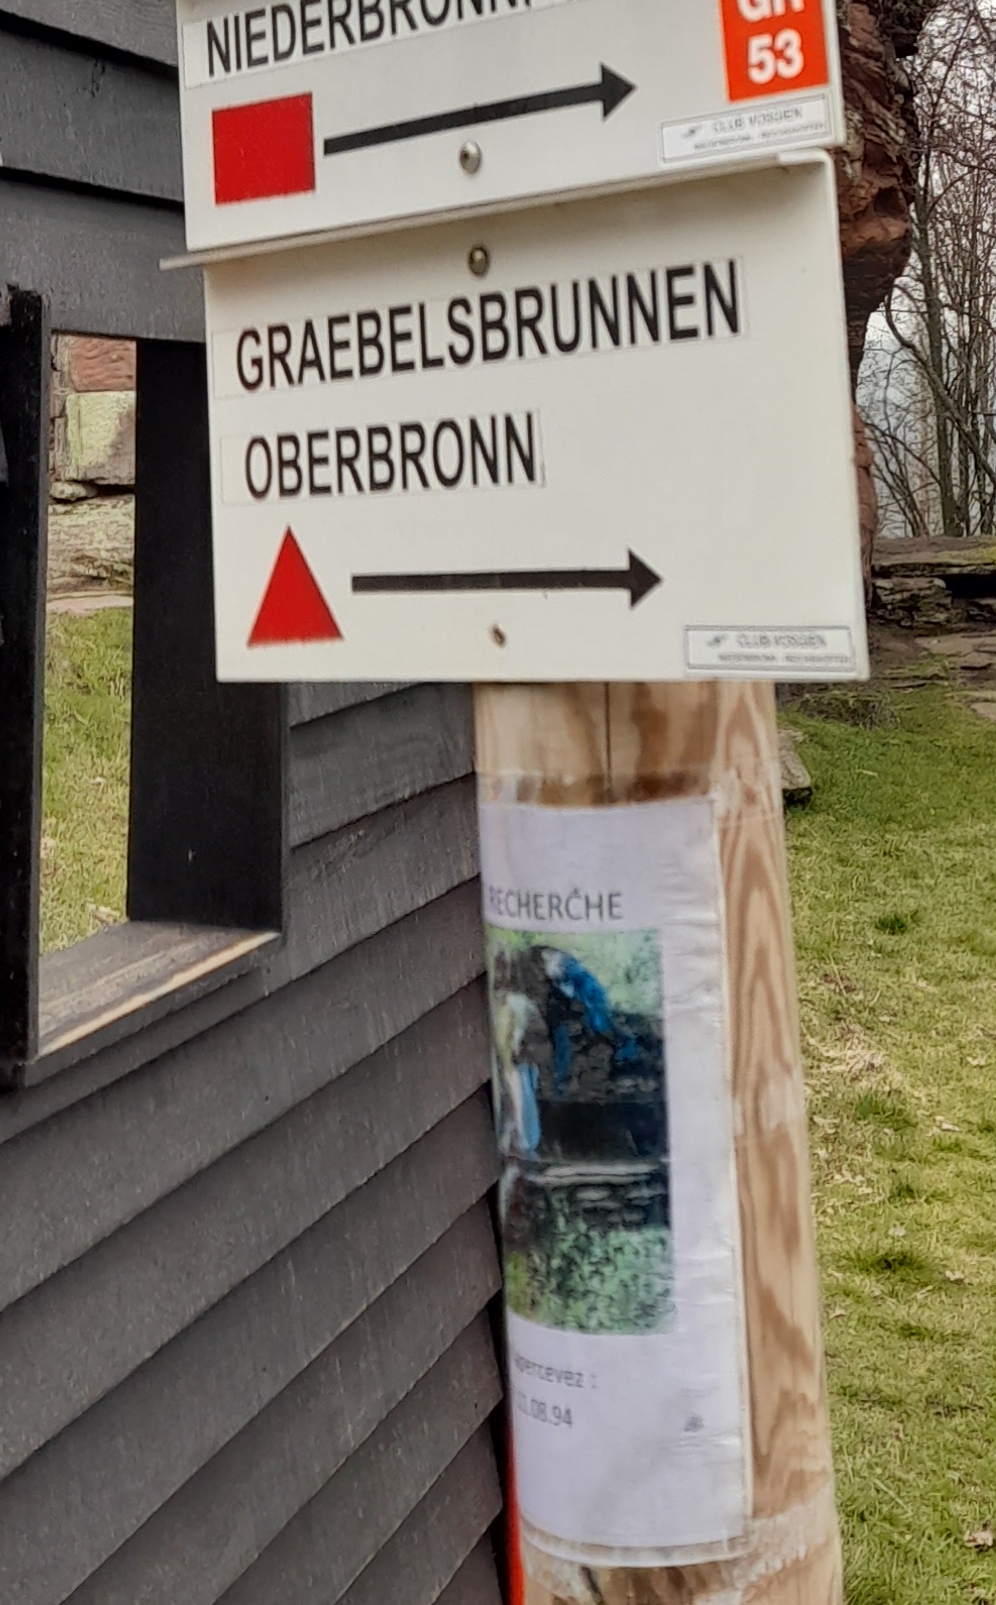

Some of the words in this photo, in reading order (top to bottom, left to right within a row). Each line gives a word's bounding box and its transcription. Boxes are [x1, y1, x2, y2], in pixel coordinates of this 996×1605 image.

[747, 28, 804, 84] 53
[236, 260, 739, 391] GRAEBELSBRUNNEN
[245, 412, 535, 499] OBERBRONN
